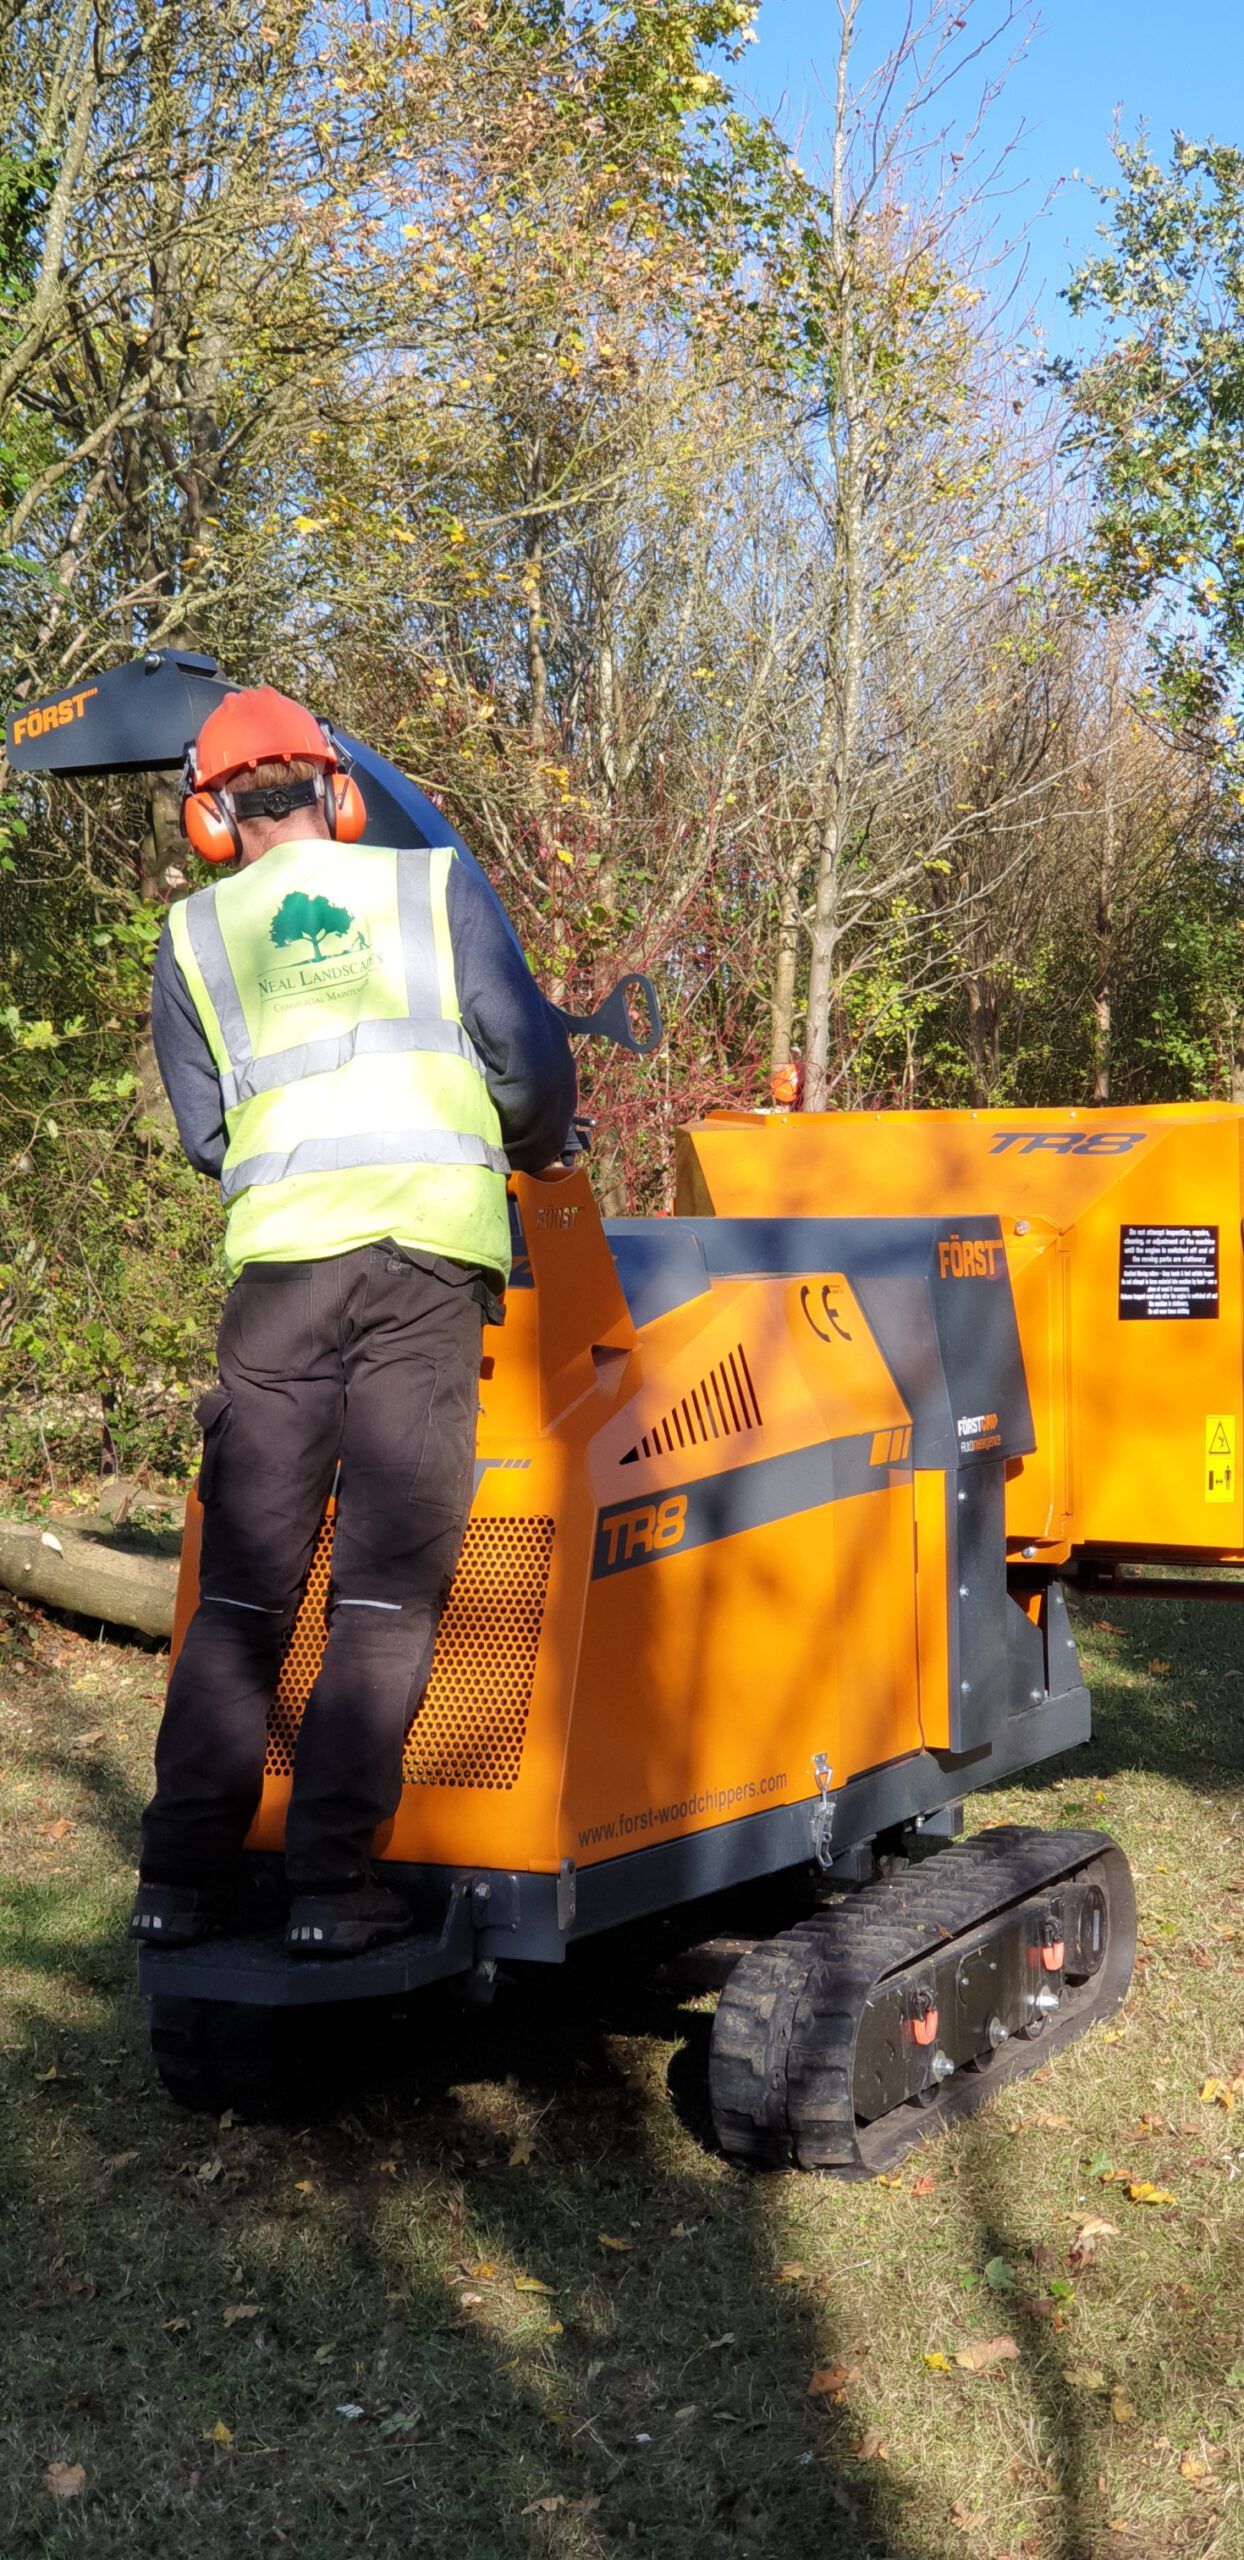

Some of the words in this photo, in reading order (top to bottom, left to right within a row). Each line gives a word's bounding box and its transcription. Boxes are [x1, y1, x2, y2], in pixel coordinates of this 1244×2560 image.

[13, 688, 98, 745] FÖRST
[988, 1132, 1147, 1155] TR8
[938, 1234, 1002, 1279] FÖRST
[603, 1494, 688, 1566] TR8
[578, 1772, 788, 1848] www.forst-woodchippers.com
